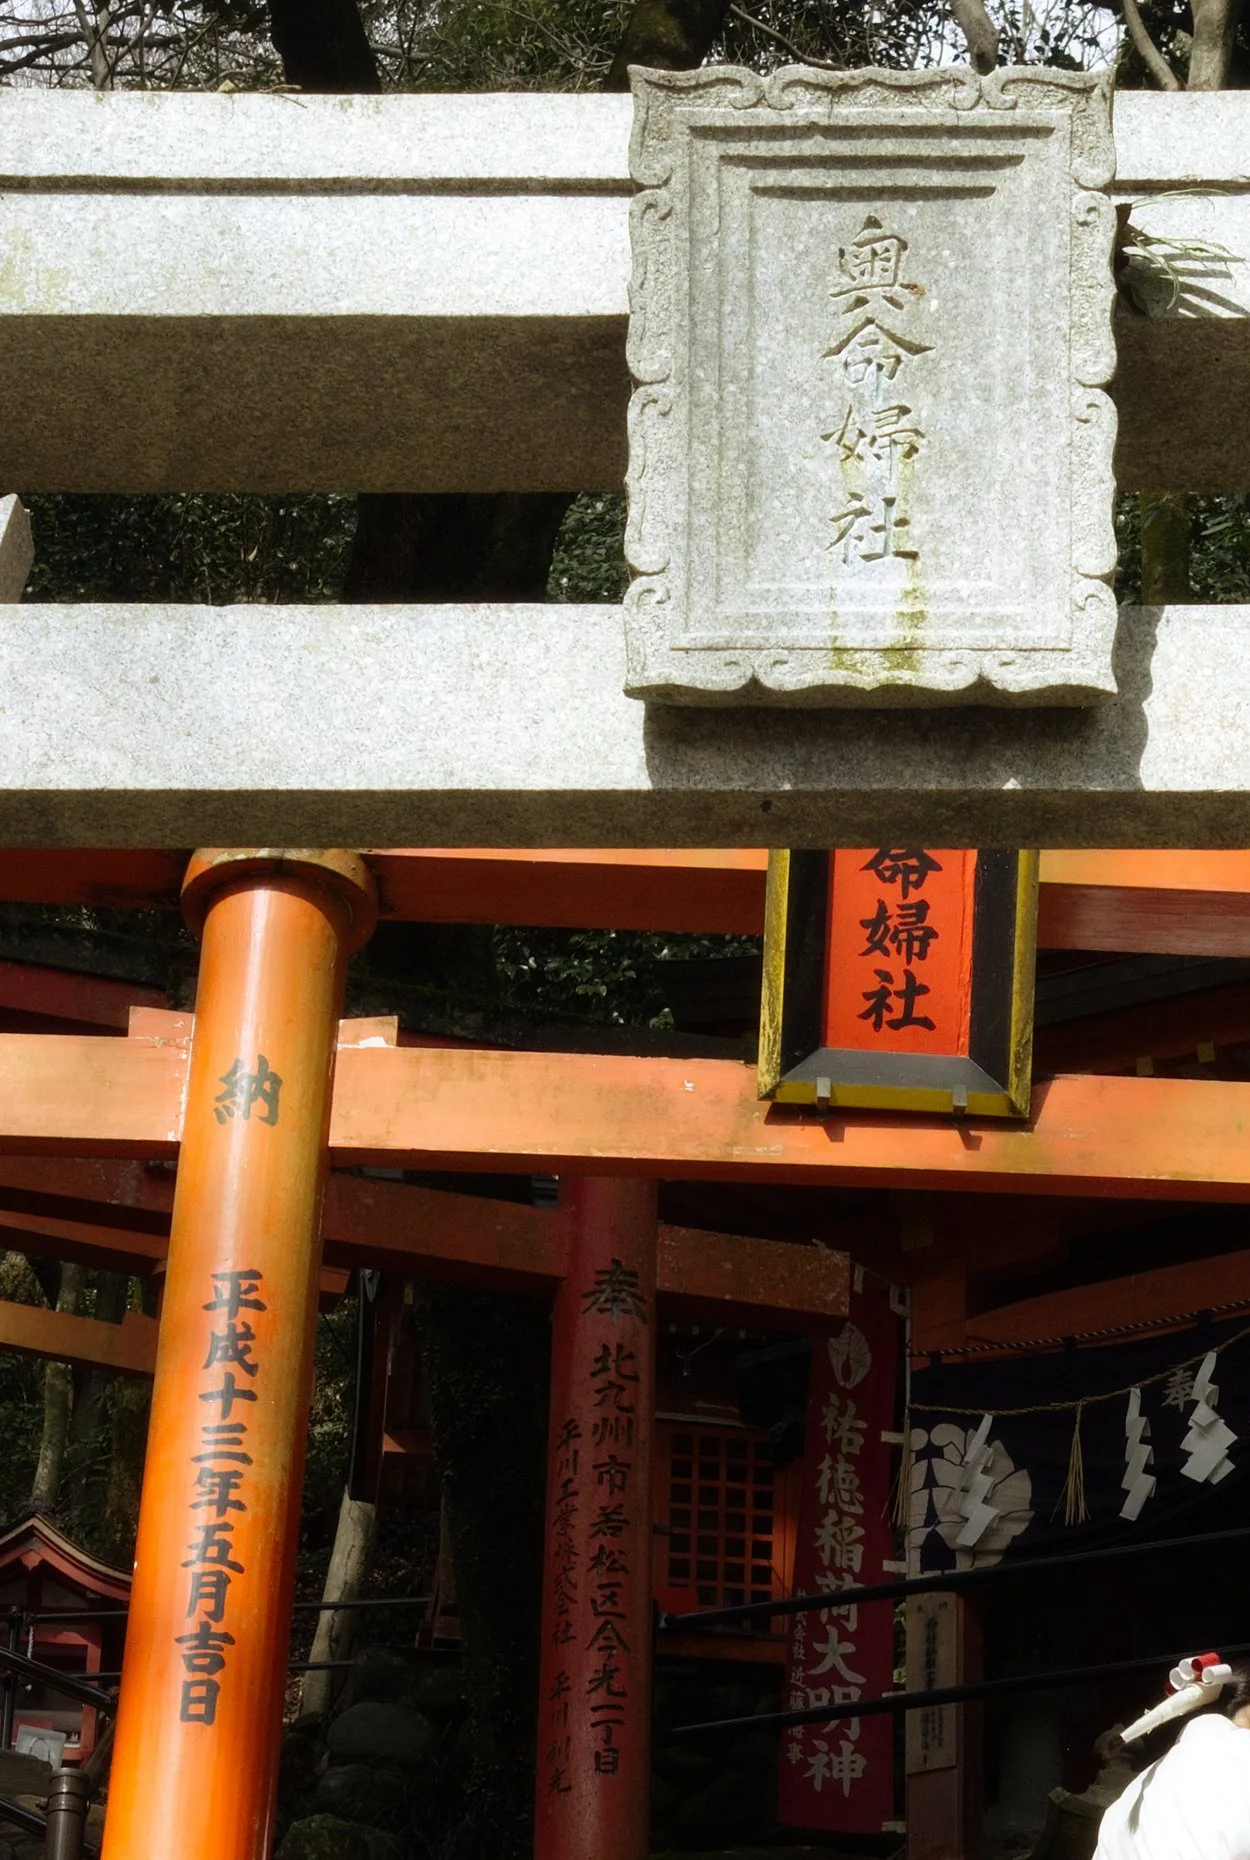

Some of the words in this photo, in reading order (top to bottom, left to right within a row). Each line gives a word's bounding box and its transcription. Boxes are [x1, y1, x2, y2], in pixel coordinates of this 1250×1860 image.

[820, 214, 936, 566] 奥命婦社
[213, 1053, 284, 1128] 納
[582, 1258, 649, 1325] 奉
[174, 1268, 268, 1728] 平成十三年五月吉日
